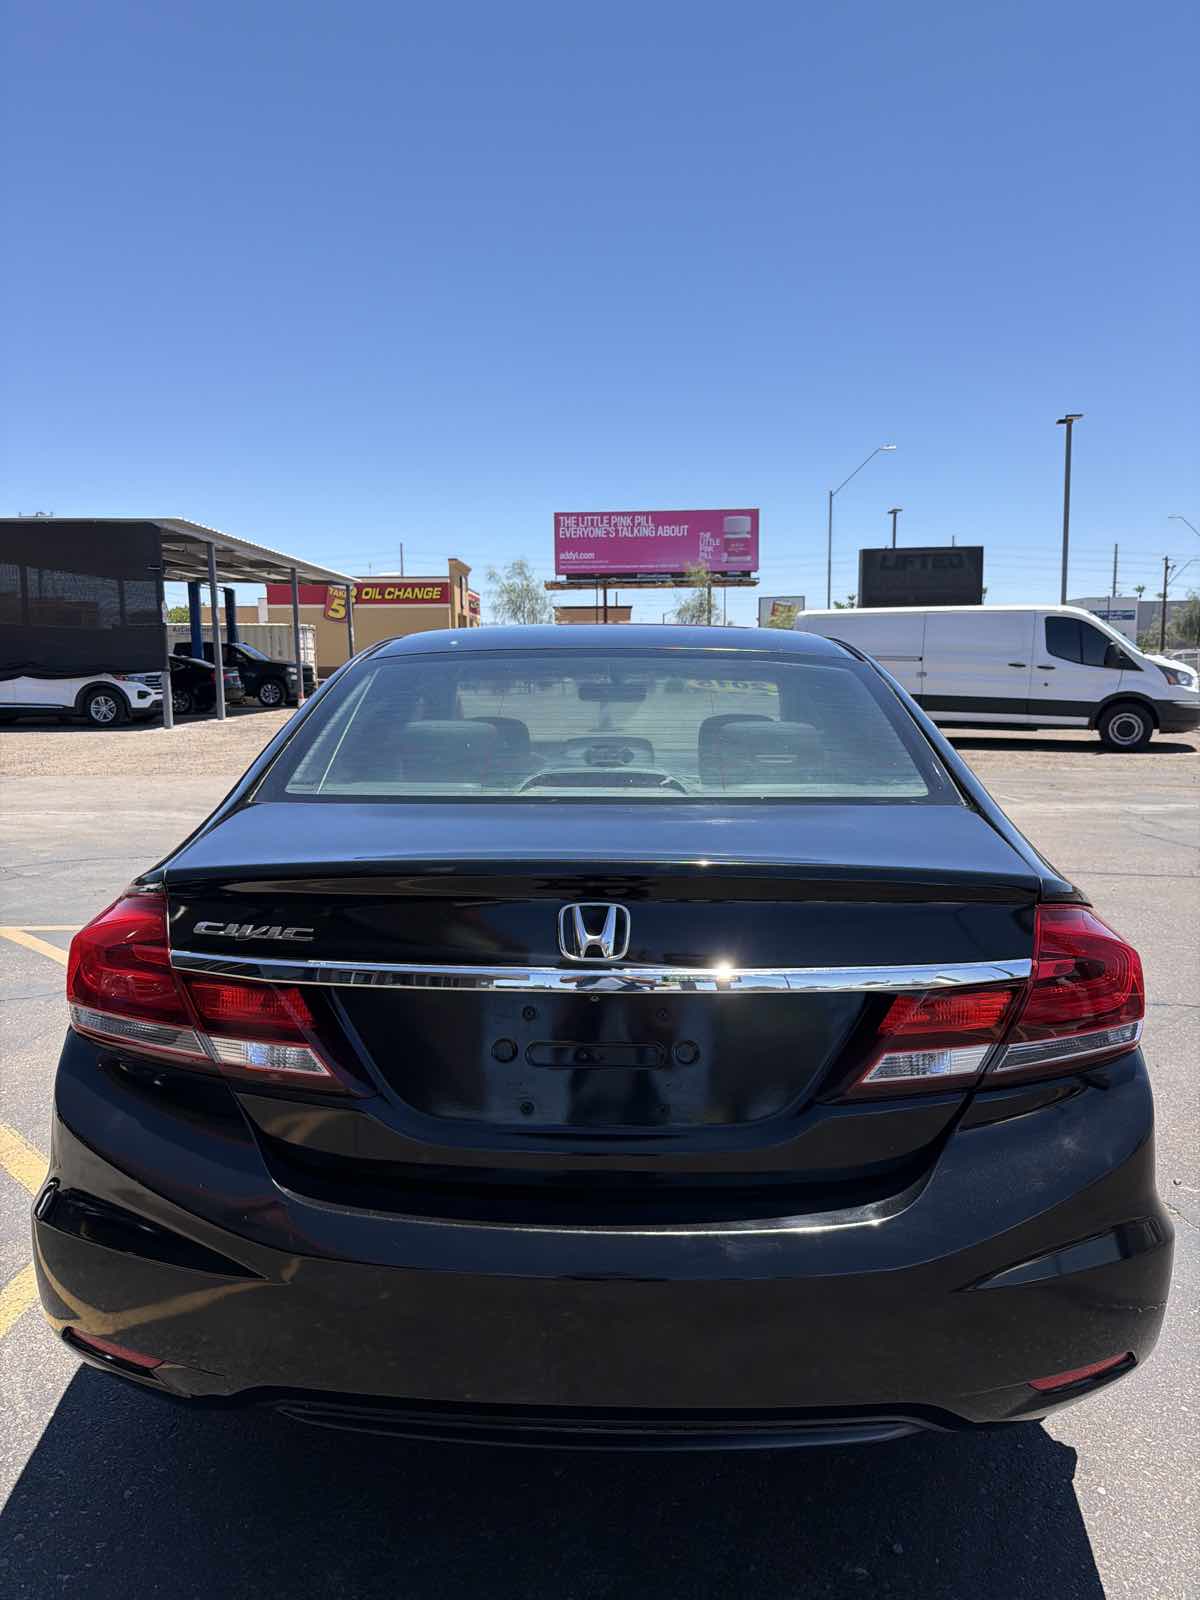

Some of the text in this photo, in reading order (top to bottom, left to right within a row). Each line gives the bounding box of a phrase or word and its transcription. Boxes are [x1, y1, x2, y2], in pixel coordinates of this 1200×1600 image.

[559, 515, 654, 527] THE LITTLE PINK PILL
[559, 525, 689, 538] EVERYONE'S TALKING ABOUT
[362, 587, 442, 600] OIL CHANGE
[327, 599, 346, 619] 5
[193, 921, 315, 941] CIVIC
